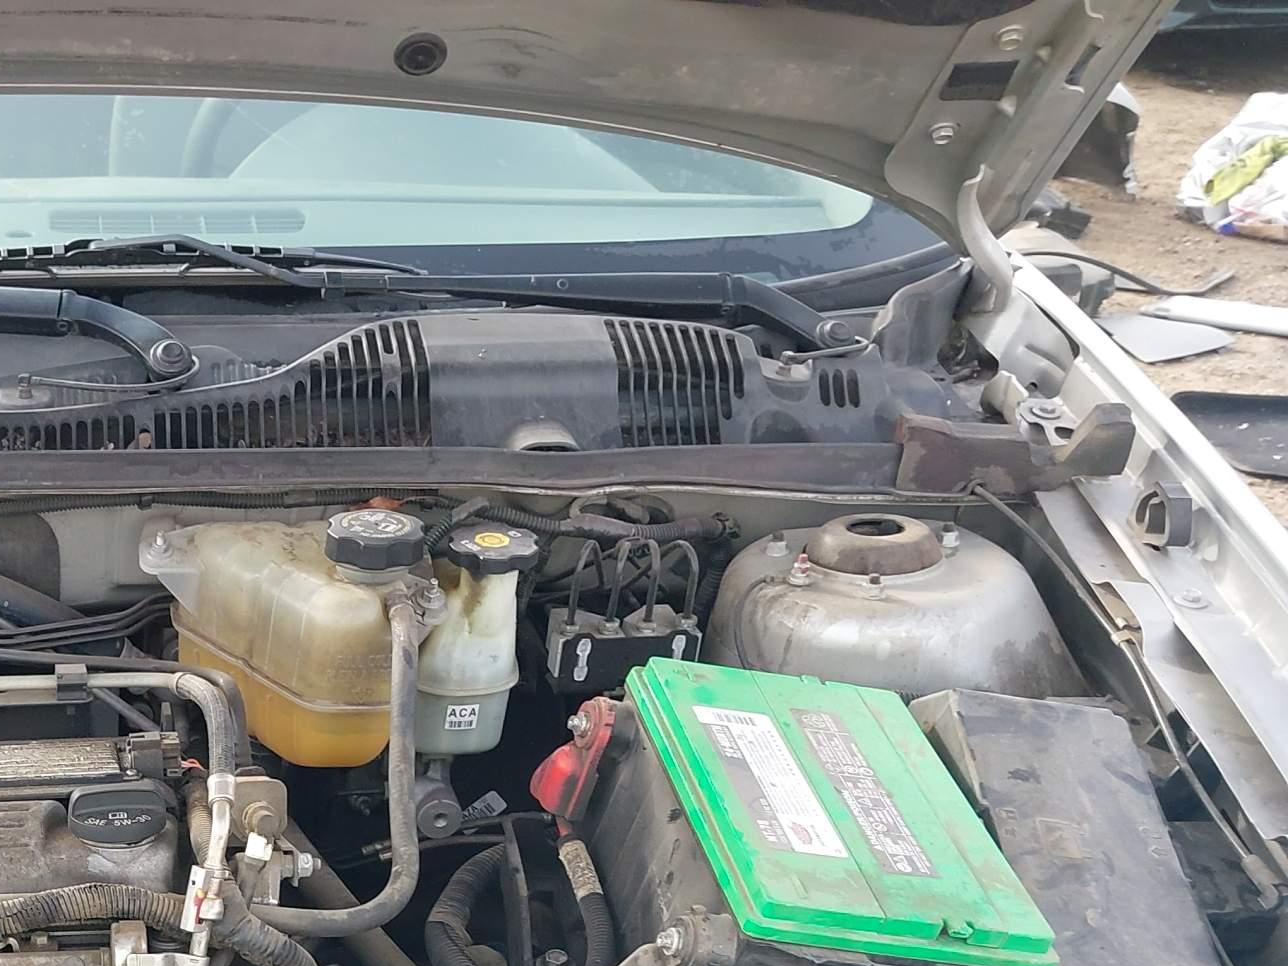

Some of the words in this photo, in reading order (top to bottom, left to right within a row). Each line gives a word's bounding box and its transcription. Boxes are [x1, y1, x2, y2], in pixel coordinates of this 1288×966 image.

[448, 707, 477, 719] ACA
[84, 817, 107, 827] SAE
[113, 814, 152, 827] 5W-30
